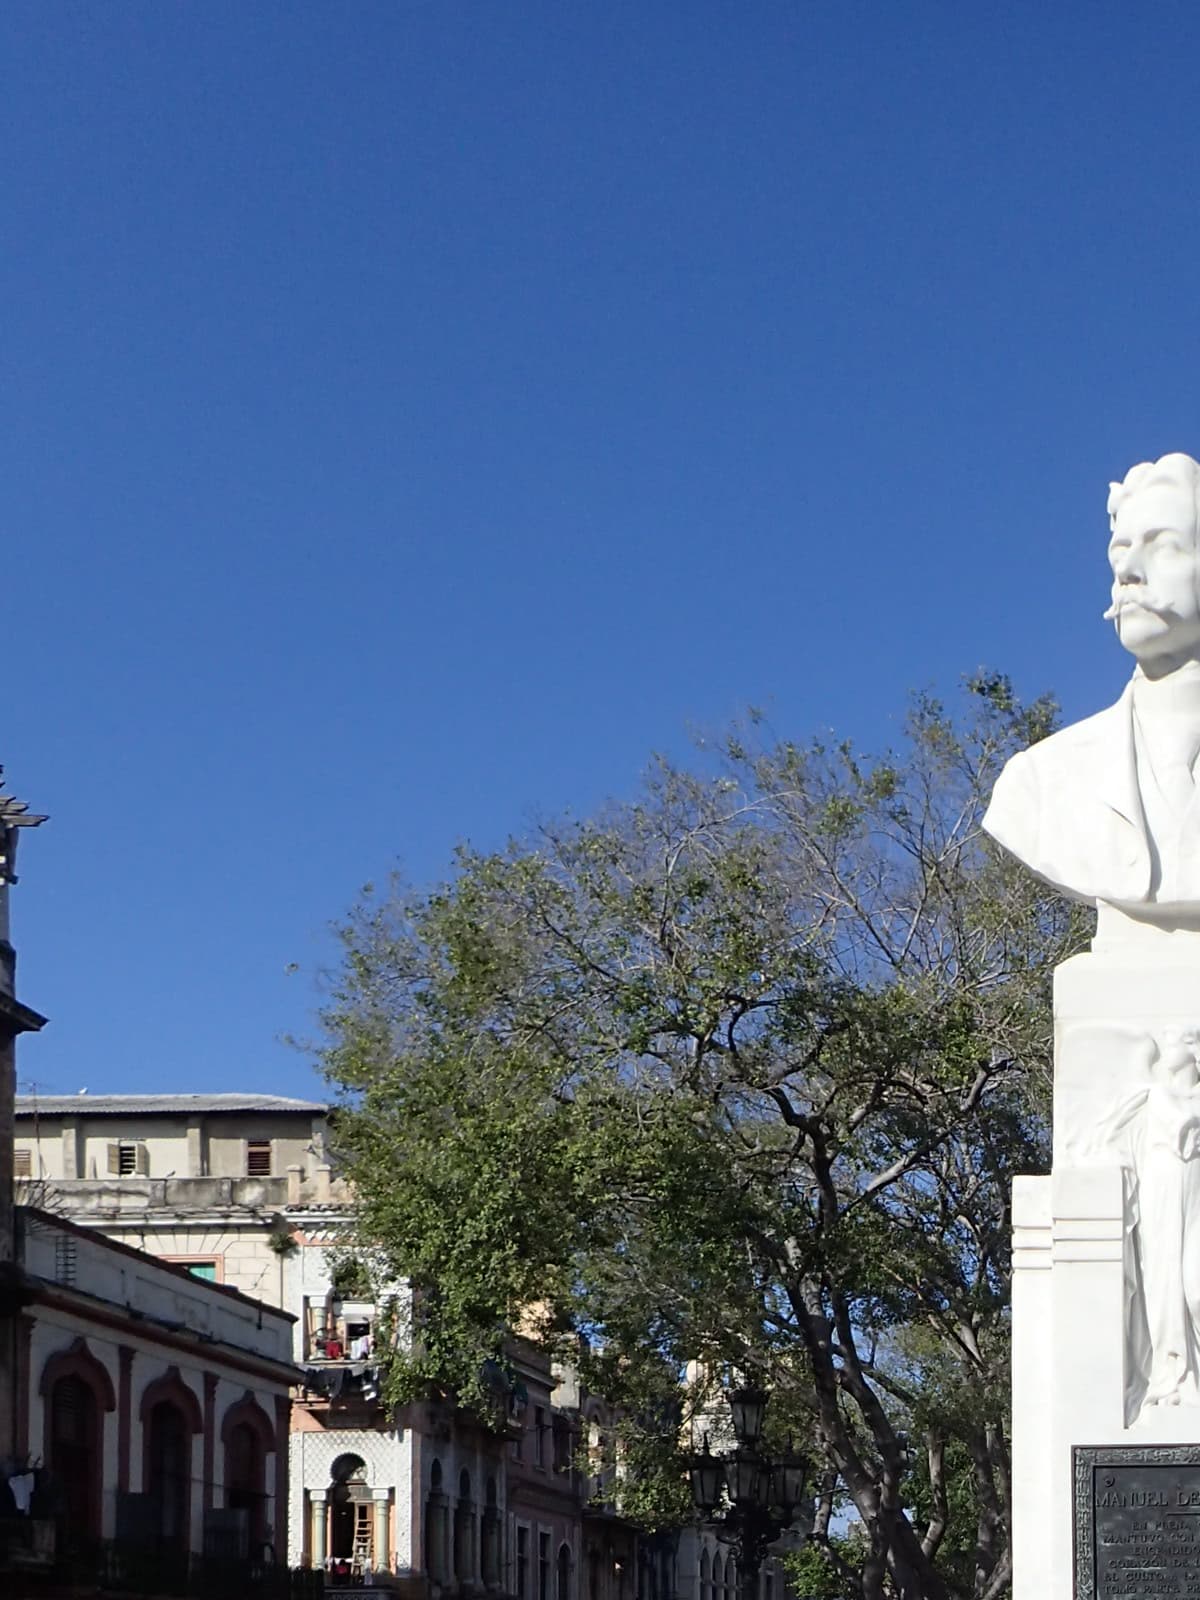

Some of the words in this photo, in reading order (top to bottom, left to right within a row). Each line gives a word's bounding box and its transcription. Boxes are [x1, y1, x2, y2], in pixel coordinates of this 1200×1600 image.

[1096, 1491, 1168, 1507] MANUEL
[1132, 1521, 1147, 1531] EN
[1103, 1533, 1163, 1544] MANTUVO
[1108, 1555, 1167, 1569] CORAZÓN
[1173, 1559, 1189, 1568] DE
[1125, 1571, 1165, 1581] CULTO
